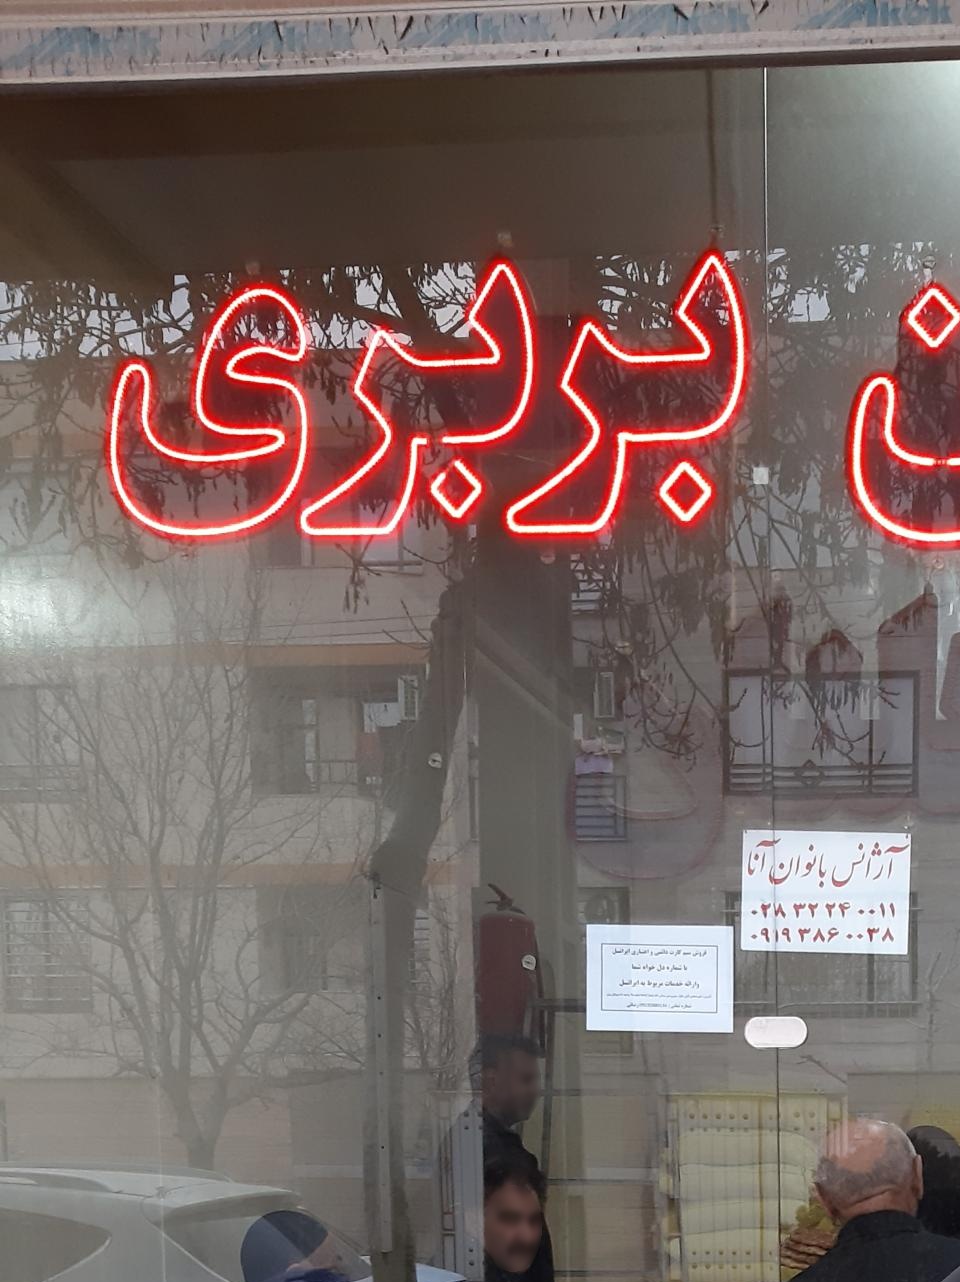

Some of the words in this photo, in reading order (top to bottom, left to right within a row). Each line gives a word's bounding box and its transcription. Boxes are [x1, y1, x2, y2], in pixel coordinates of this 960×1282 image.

[106, 253, 749, 544] بربری
[769, 844, 828, 888] بانوان
[832, 841, 910, 888] آژانس
[825, 902, 851, 919] ۲۴
[857, 902, 896, 919] ۰۰۱۱
[750, 927, 791, 943] ۰۹۱۹
[798, 927, 839, 943] ۳۸۶
[846, 927, 894, 943] ۰۰۳۸
